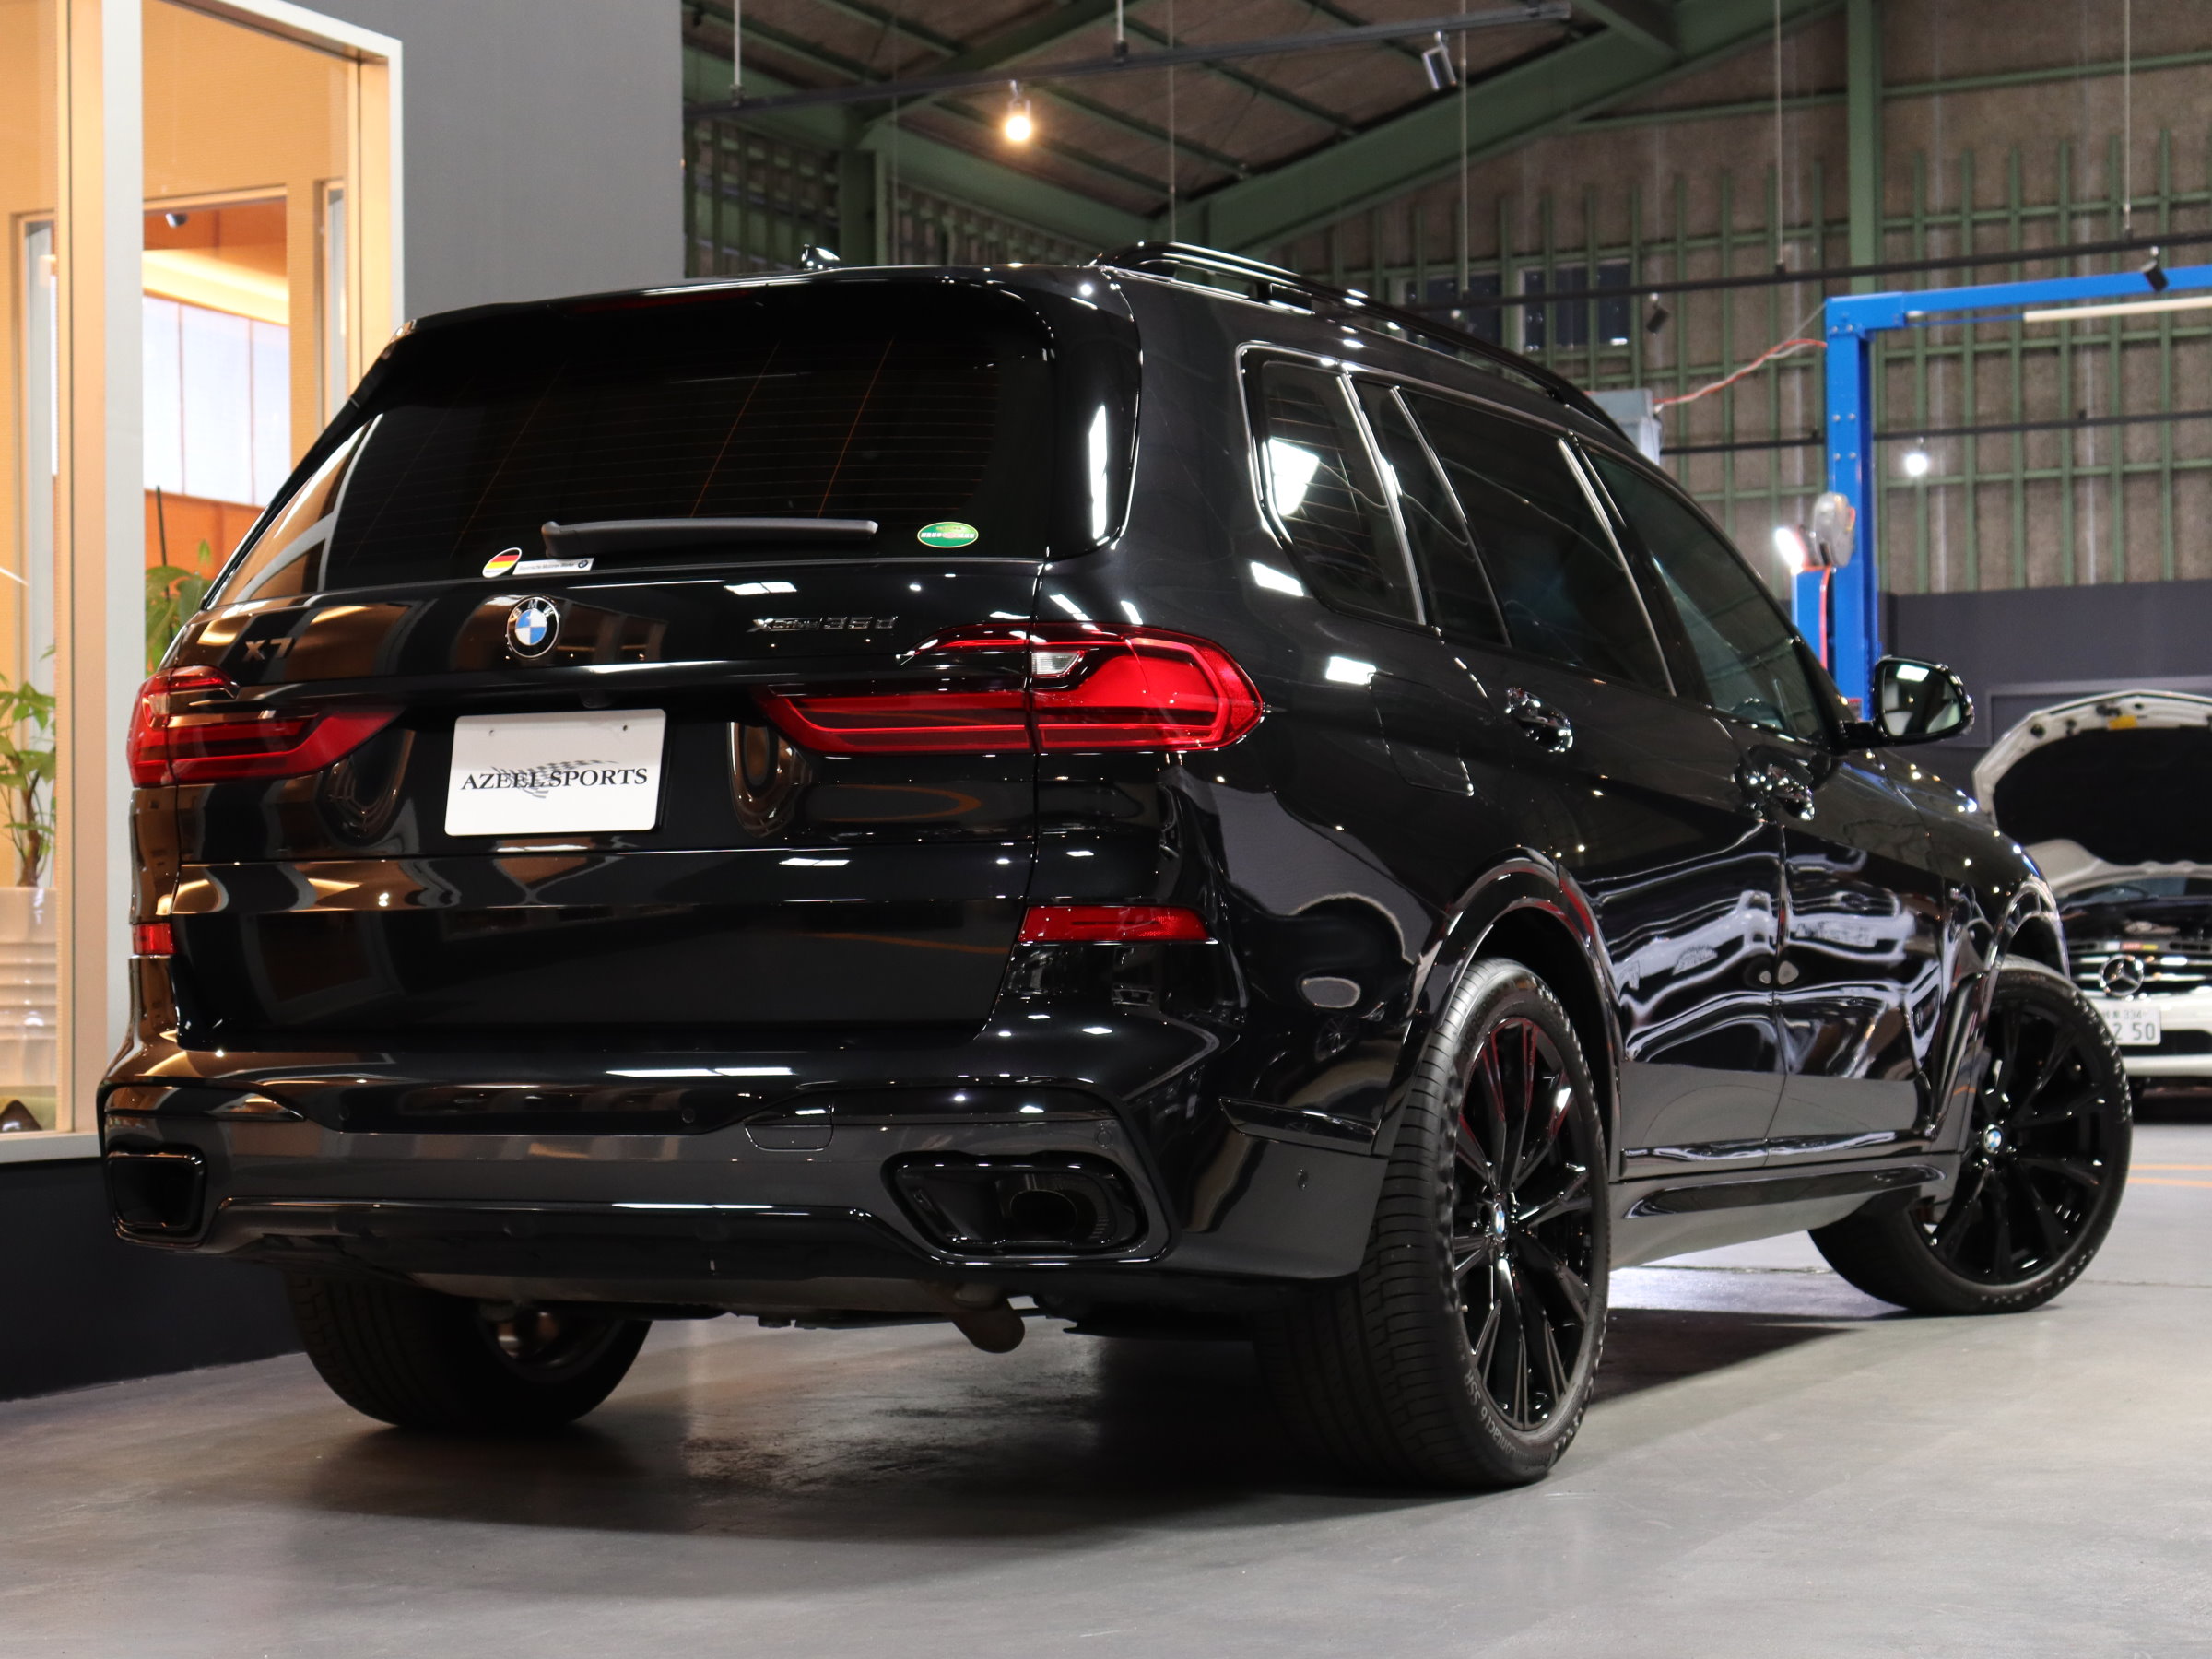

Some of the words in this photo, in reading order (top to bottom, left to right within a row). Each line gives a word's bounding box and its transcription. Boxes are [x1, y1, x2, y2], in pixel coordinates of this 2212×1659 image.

[509, 599, 555, 623] BMW
[241, 637, 292, 662] X7
[461, 772, 551, 790] AZEEL
[549, 768, 648, 788] SPORTS
